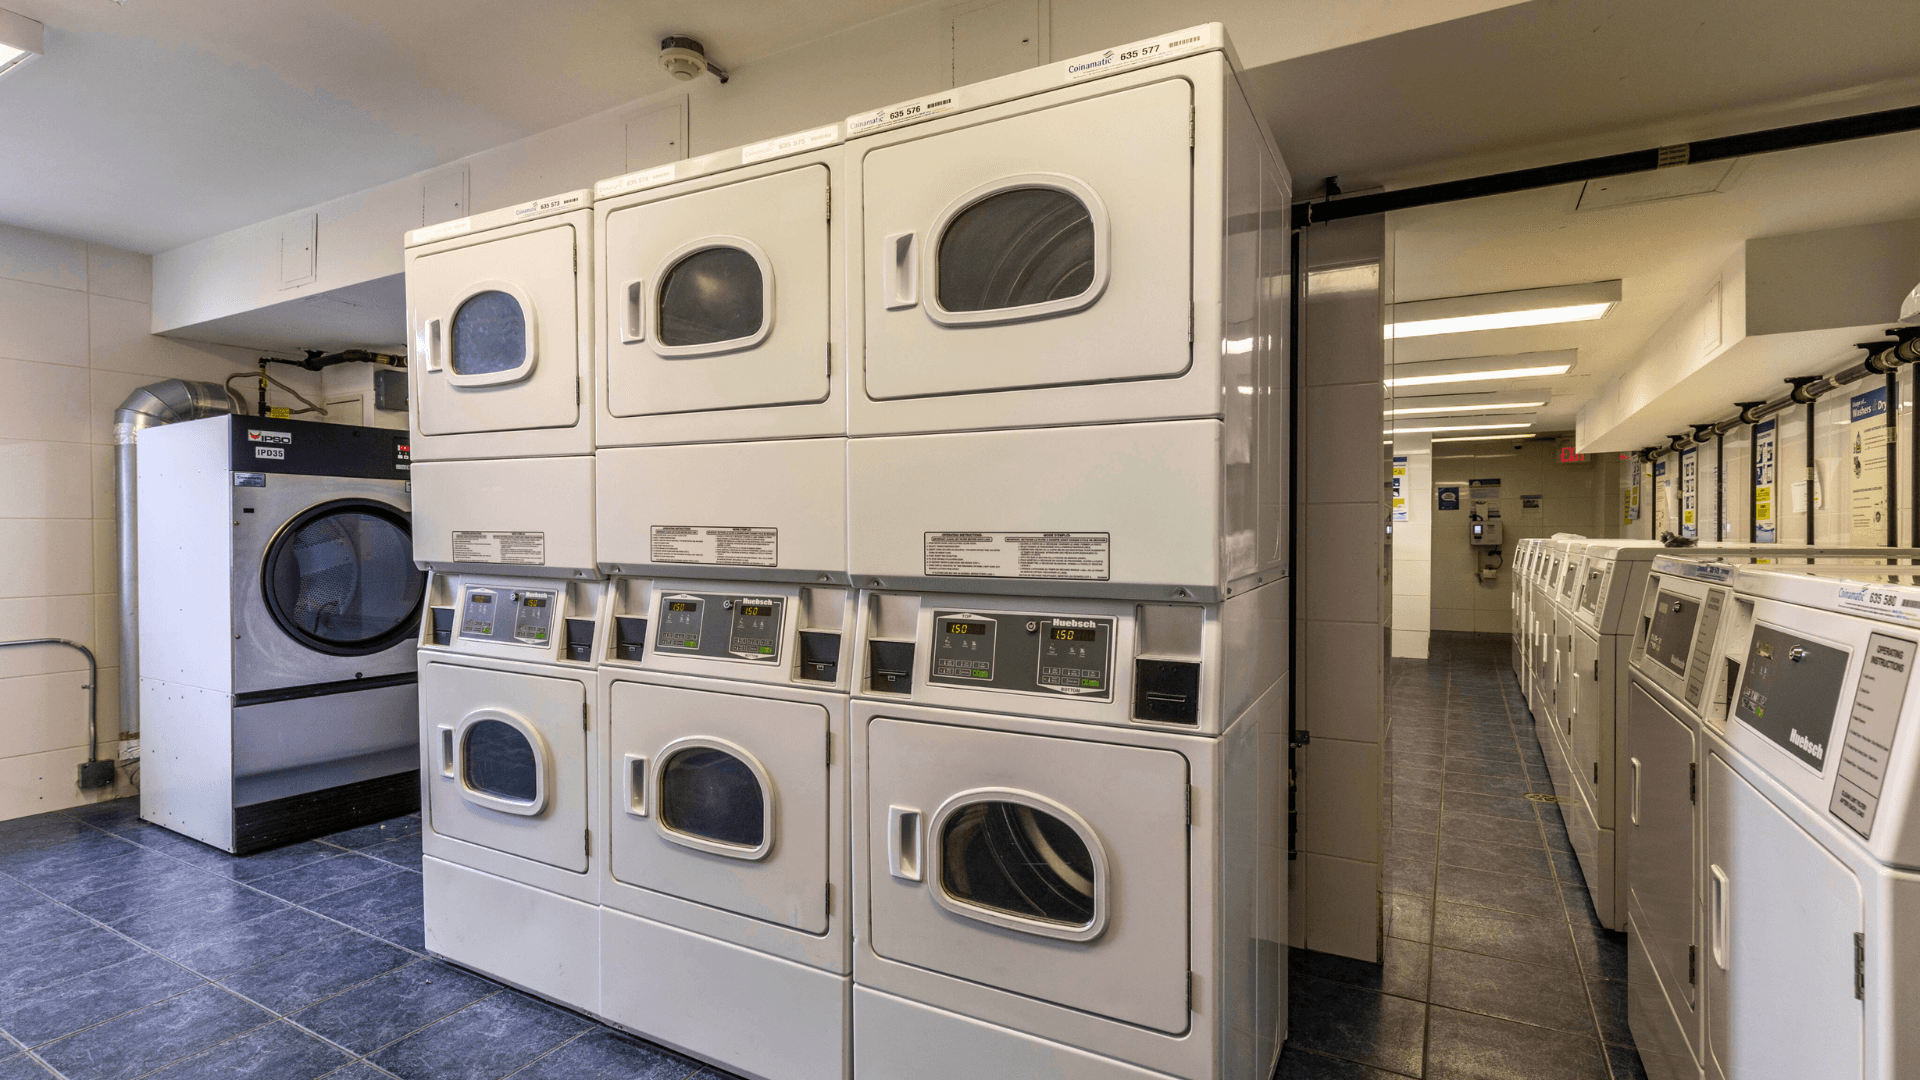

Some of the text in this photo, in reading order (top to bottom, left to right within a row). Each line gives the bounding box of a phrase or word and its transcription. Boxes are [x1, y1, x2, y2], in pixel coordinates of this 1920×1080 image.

[1068, 57, 1112, 74] Coinamatic
[1120, 49, 1139, 61] 635
[1142, 44, 1160, 56] 577
[889, 110, 904, 120] 635
[906, 105, 921, 115] 576
[261, 435, 291, 443] IPSO
[257, 448, 284, 458] IPD35
[742, 597, 773, 606] Huebsch
[1869, 592, 1882, 604] 635
[1883, 594, 1897, 607] 580
[1052, 618, 1097, 629] Huebsch
[1790, 728, 1824, 761] Huebsch
